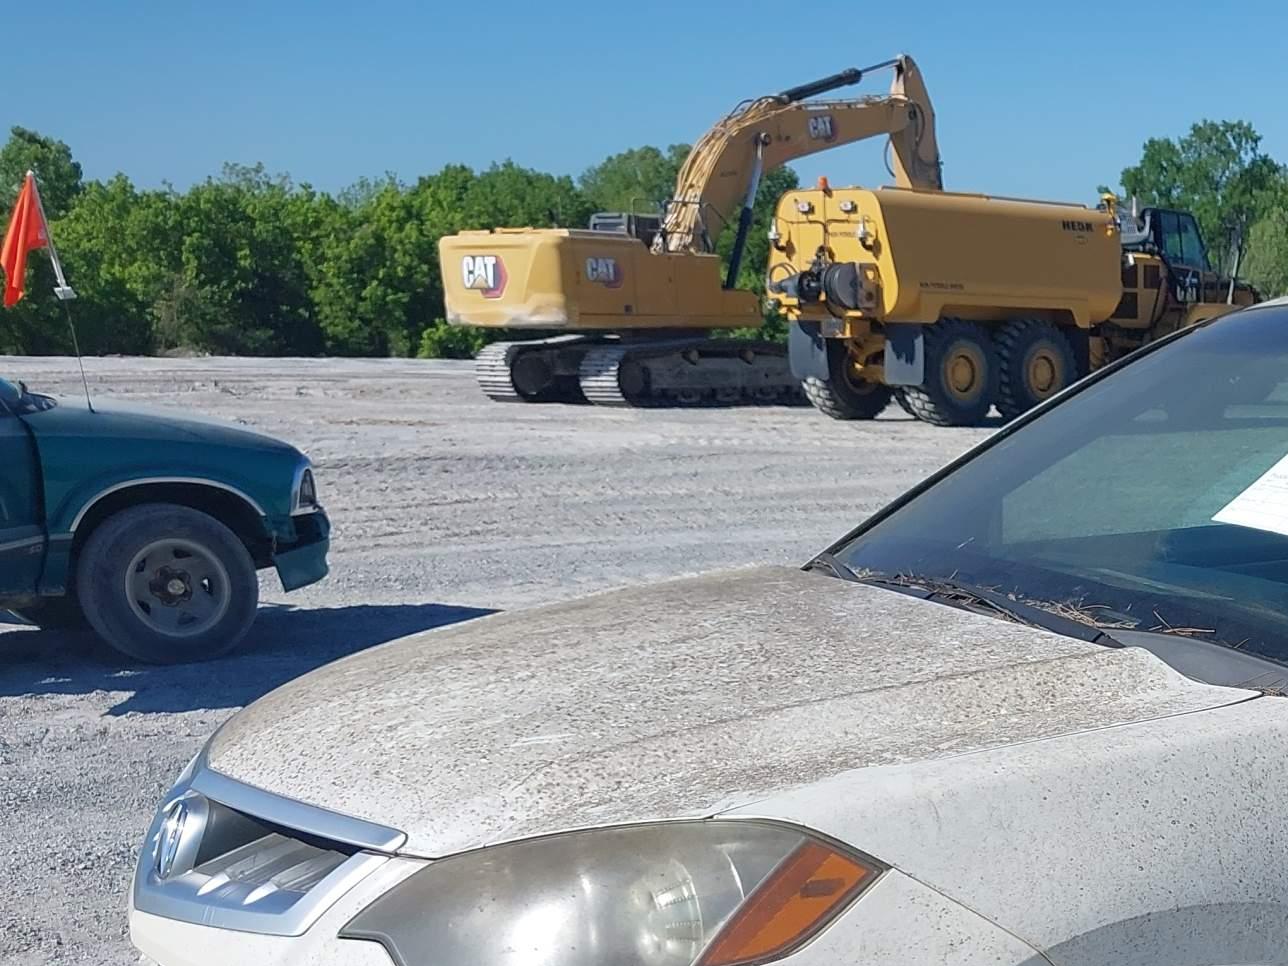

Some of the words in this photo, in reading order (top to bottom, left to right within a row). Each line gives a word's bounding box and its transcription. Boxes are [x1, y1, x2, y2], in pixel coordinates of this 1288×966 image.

[808, 116, 833, 139] CAT
[462, 255, 497, 289] CAT
[586, 257, 616, 281] CAT
